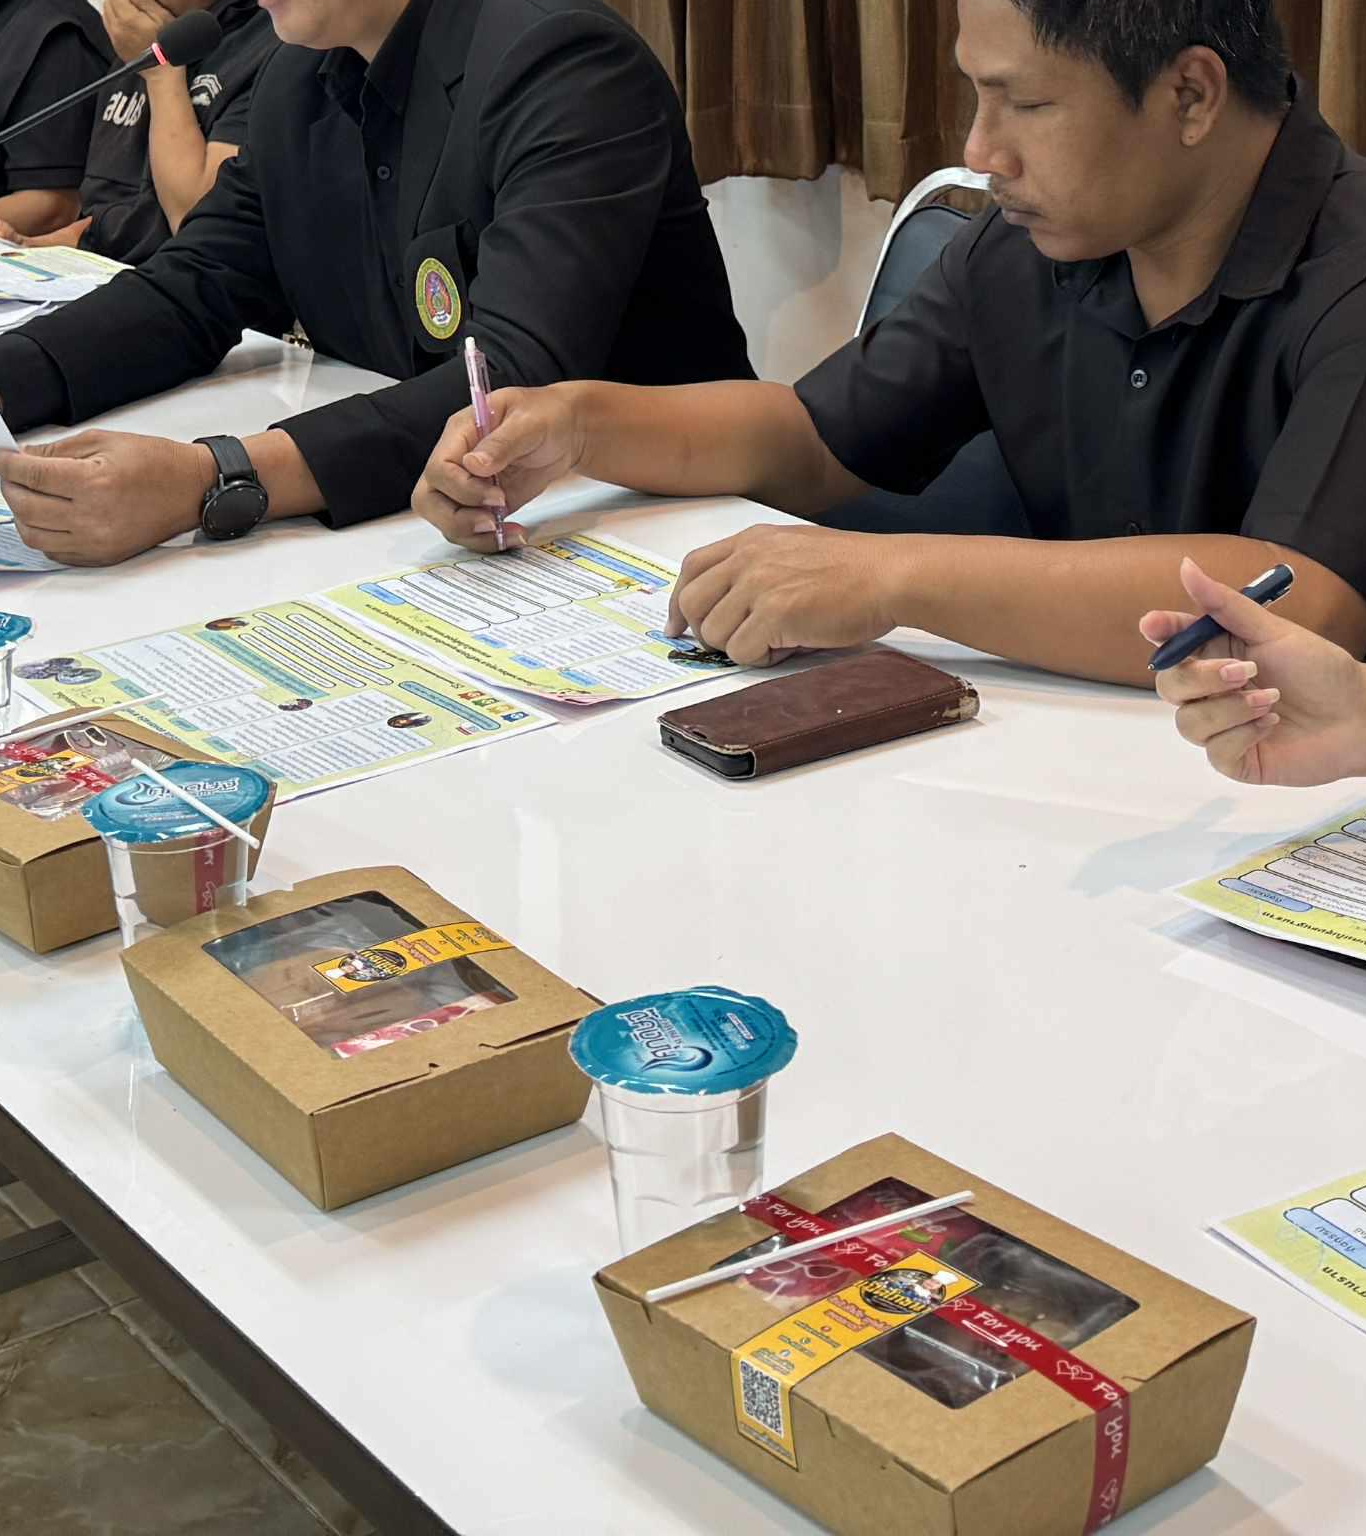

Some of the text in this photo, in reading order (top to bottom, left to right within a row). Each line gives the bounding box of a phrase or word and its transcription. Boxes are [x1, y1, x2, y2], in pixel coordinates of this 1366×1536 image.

[766, 1203, 826, 1236] For you
[1310, 1223, 1361, 1254] กิจกรรม
[865, 1253, 891, 1268] Fo
[973, 1310, 1043, 1351] For you
[1092, 1381, 1124, 1460] For you
